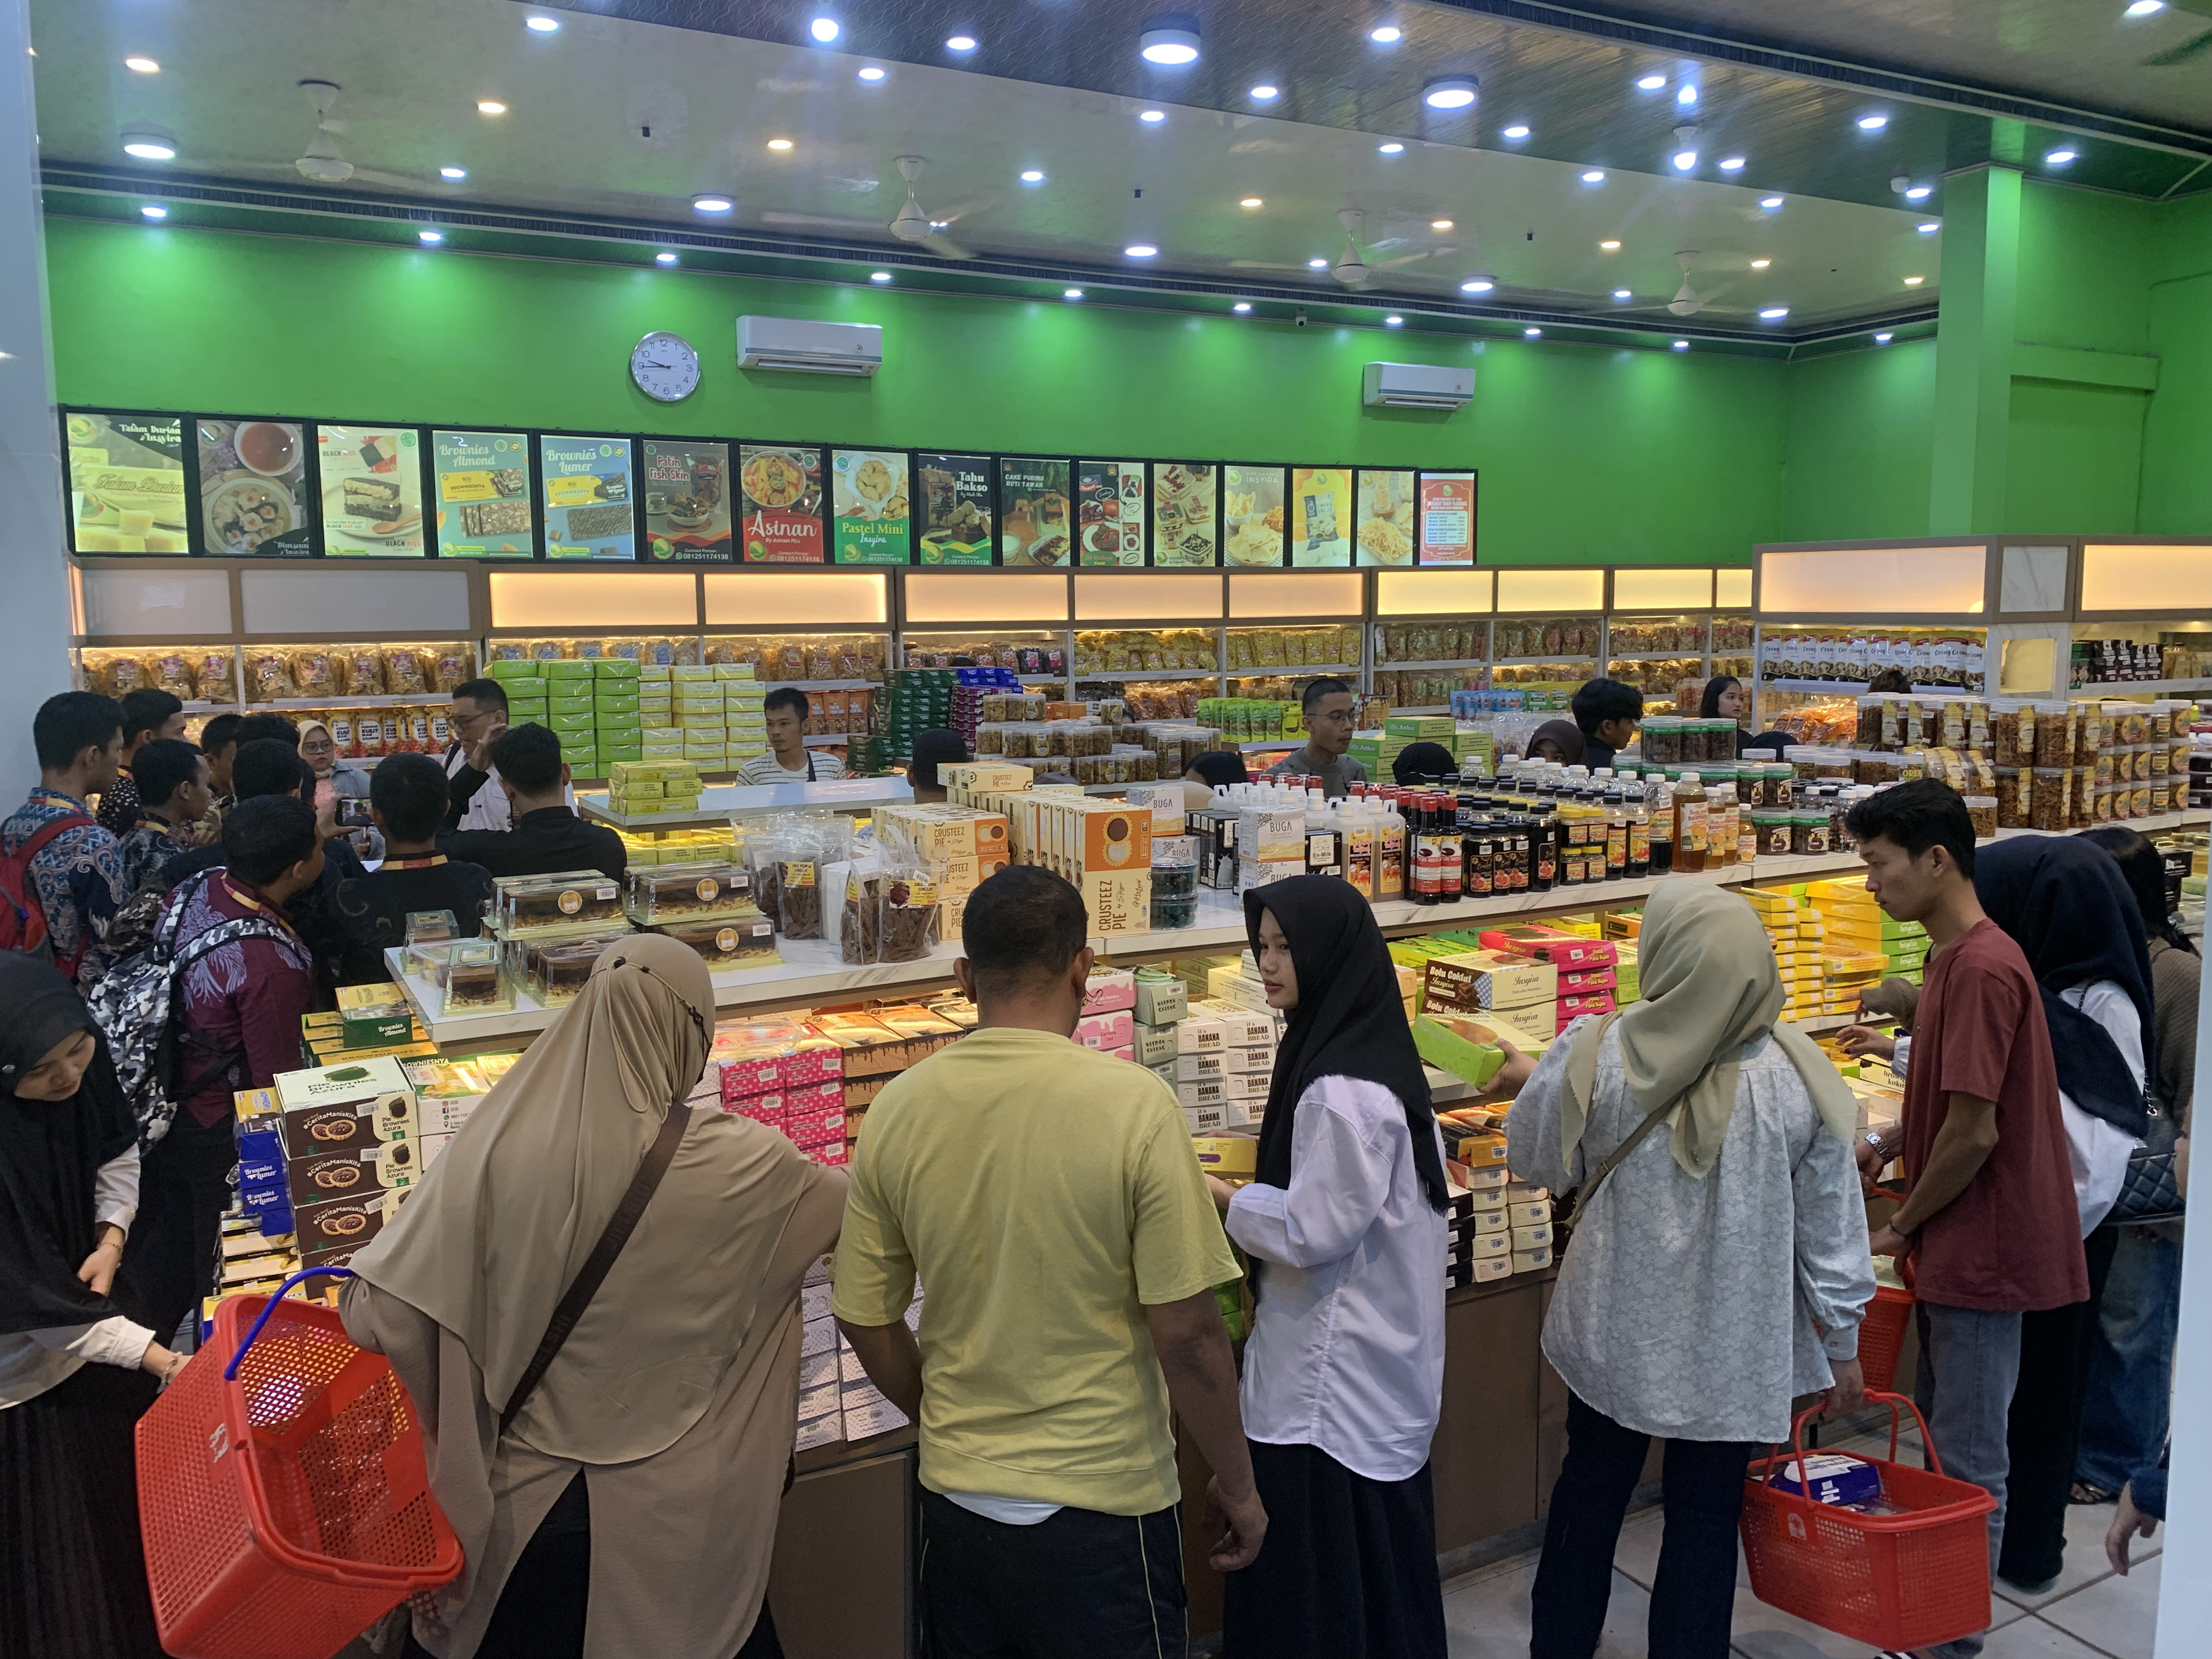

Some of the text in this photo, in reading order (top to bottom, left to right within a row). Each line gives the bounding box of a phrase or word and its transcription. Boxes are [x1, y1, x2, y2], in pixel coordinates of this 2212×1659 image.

[119, 423, 181, 435] Talam Durian
[439, 444, 489, 456] Brownies
[546, 450, 597, 461] Brownies
[453, 455, 496, 467] Almond
[657, 455, 681, 468] Patin
[559, 461, 592, 476] Lumer
[649, 468, 690, 481] Fish Skin
[959, 472, 984, 482] Tahu
[956, 482, 988, 492] Bakso
[748, 510, 817, 537] Asinan
[842, 522, 903, 535] Pastel Mini
[860, 534, 887, 548] Insyira
[1153, 799, 1173, 809] BUGA
[934, 827, 964, 838] CRUSTEEZ
[1271, 822, 1292, 832] BUGA
[935, 838, 945, 848] PIE
[1099, 880, 1112, 931] CRUSTEEZ
[1113, 912, 1126, 930] PIE
[1900, 924, 1918, 934] Insyira
[1503, 941, 1527, 953] Insyira
[1899, 940, 1917, 951] Insyira
[1900, 956, 1918, 967] Insyira
[1430, 966, 1446, 978] Bolu
[1430, 977, 1454, 989] Insyira
[1513, 974, 1539, 986] Insyira
[1426, 1000, 1443, 1012] Bolu
[1510, 1012, 1538, 1024] Insyira
[378, 1023, 403, 1032] Brownies
[384, 1028, 406, 1037] Almond
[1247, 1026, 1268, 1036] BANANA
[1198, 1033, 1220, 1042] BANANA
[399, 1058, 449, 1067] ROWNIESNYA
[1248, 1052, 1269, 1062] BANANA
[1198, 1059, 1220, 1069] BANANA
[1248, 1077, 1269, 1087] BANANA
[1883, 1070, 1905, 1084] brown
[309, 1077, 377, 1092] Brownies
[311, 1085, 355, 1095] Azura
[1198, 1086, 1219, 1096] BANANA
[303, 1111, 358, 1130] #CeritaManisKita
[1198, 1112, 1220, 1122] BANANA
[382, 1119, 409, 1127] Brownies
[1199, 1121, 1221, 1129] BREAD
[244, 1165, 273, 1175] Brownies
[307, 1158, 361, 1177] #CeritaManisKita
[386, 1165, 413, 1174] Brownies
[256, 1170, 277, 1180] Lumer
[258, 1195, 279, 1205] Lumer
[313, 1205, 367, 1225] #CeritaManisKita
